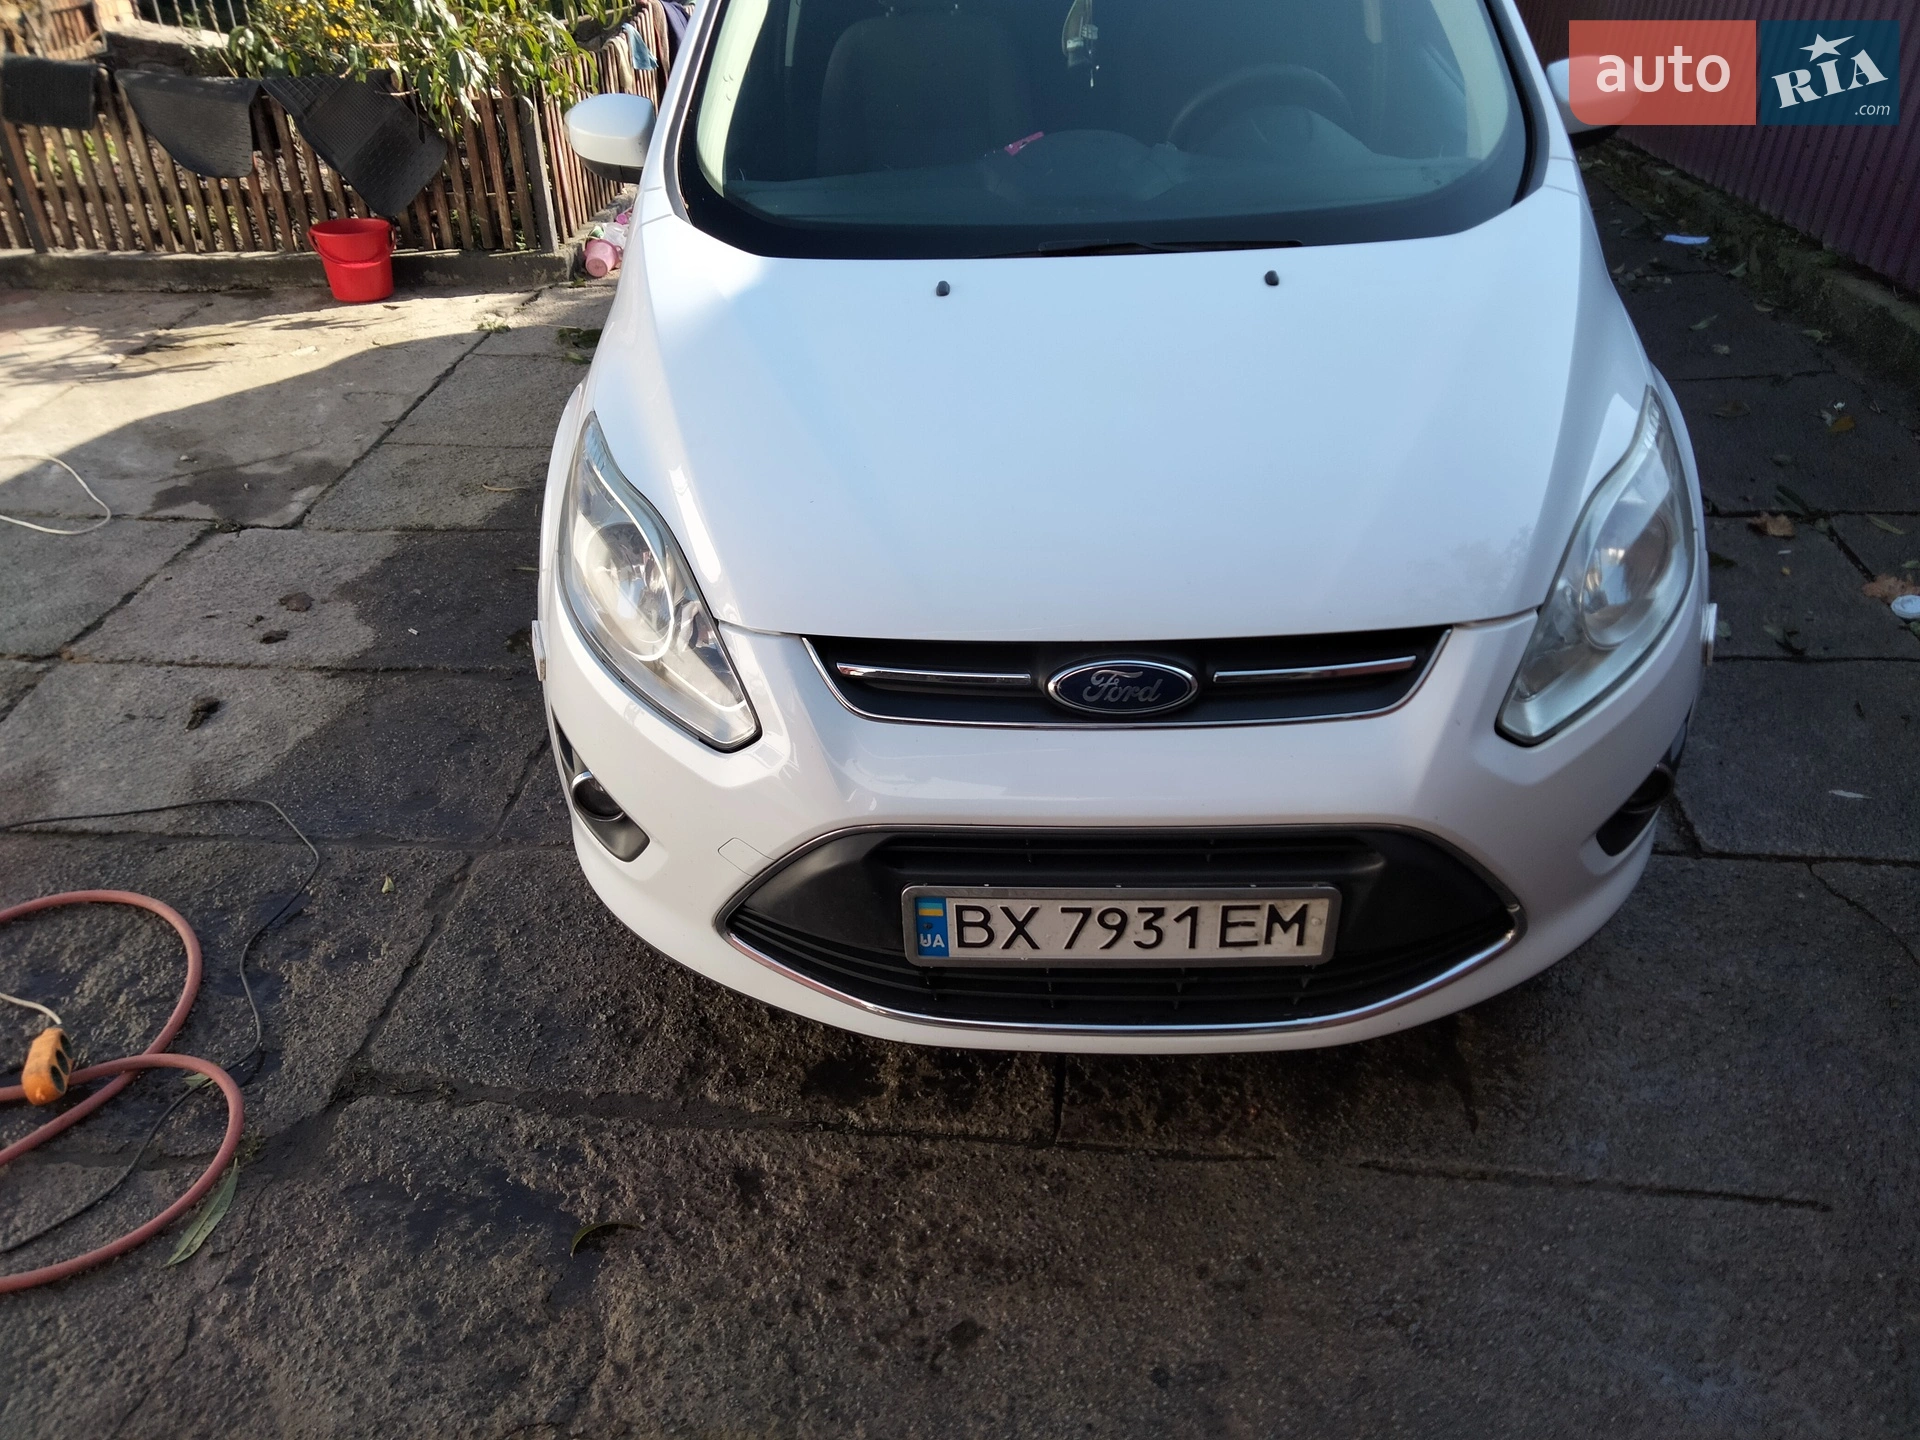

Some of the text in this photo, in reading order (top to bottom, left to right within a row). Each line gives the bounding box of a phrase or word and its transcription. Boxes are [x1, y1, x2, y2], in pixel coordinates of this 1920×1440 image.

[1082, 669, 1163, 703] Ford
[919, 934, 946, 948] UA
[1060, 905, 1199, 950] 7931
